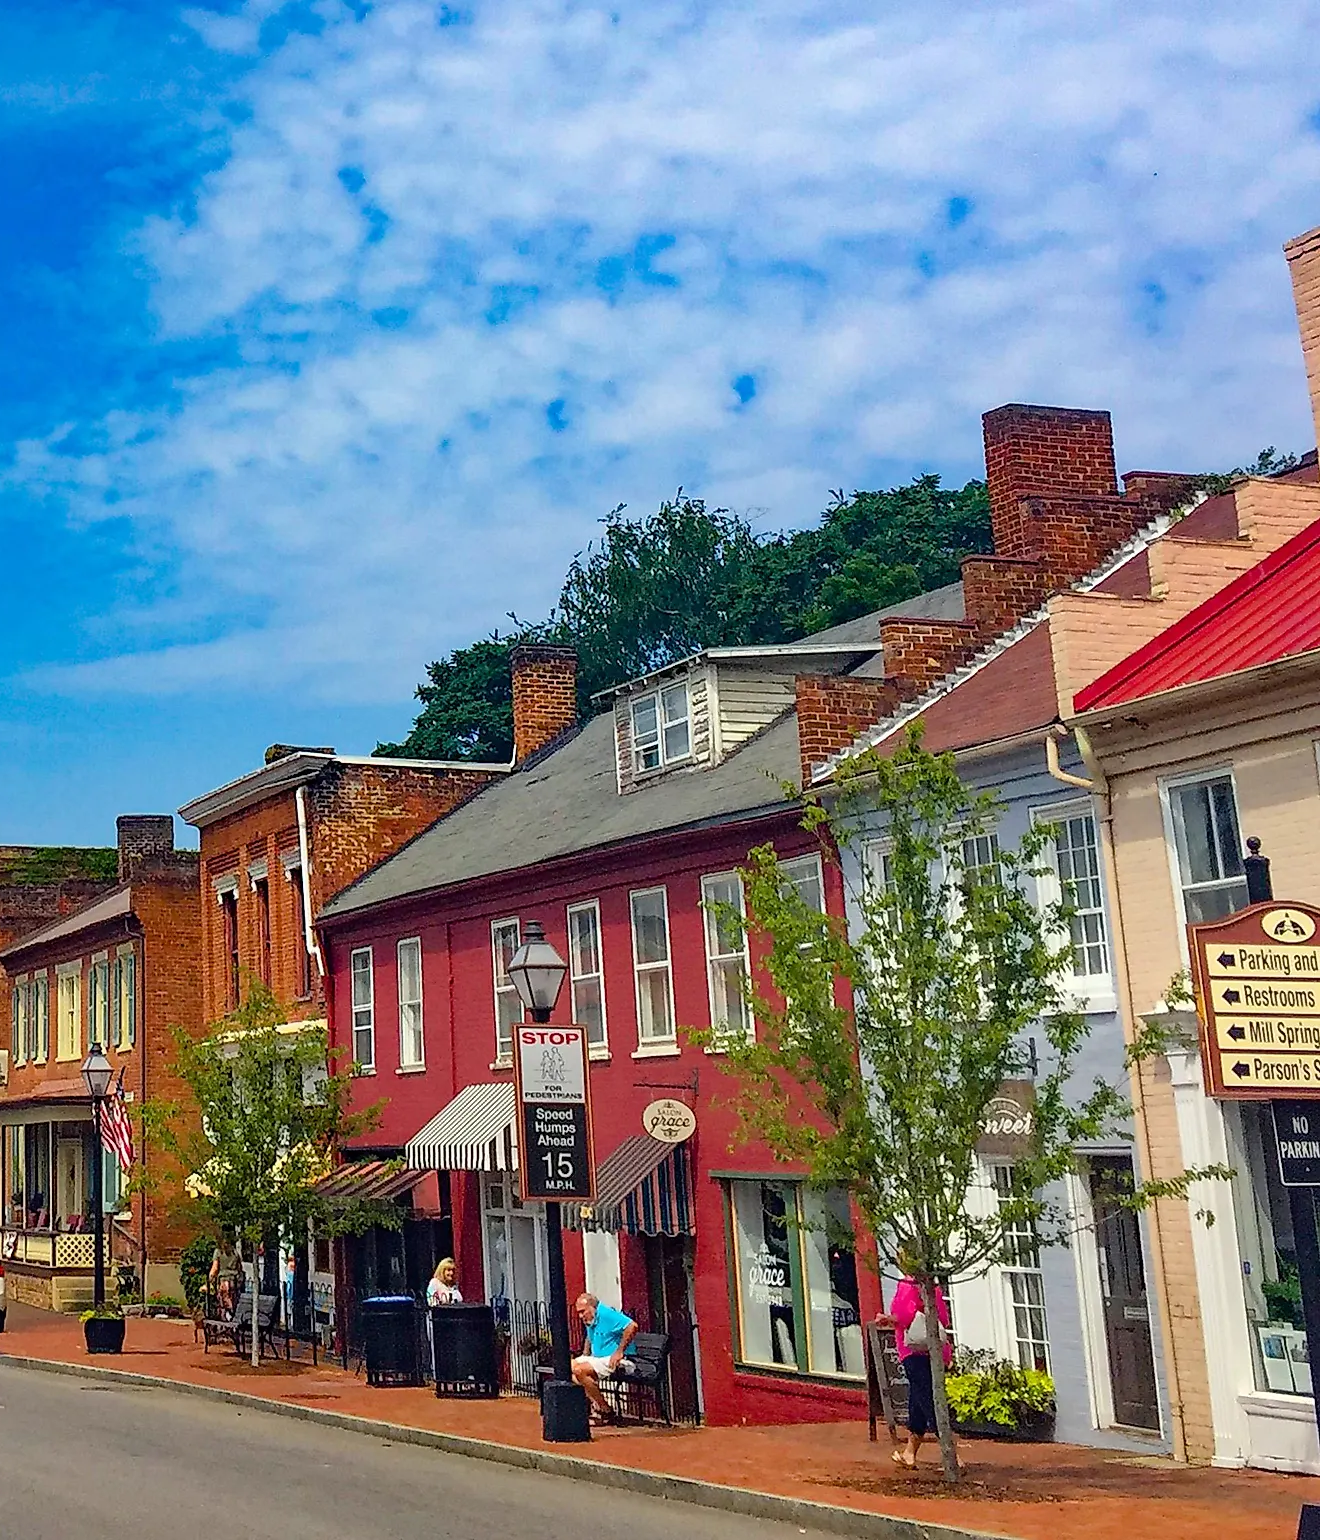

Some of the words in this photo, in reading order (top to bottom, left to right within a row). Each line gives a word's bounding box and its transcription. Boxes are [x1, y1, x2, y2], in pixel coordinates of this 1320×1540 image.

[1239, 948, 1291, 975] Parking
[1293, 950, 1319, 972] and
[1243, 984, 1316, 1008] Restrooms
[521, 1031, 579, 1045] STOP
[1249, 1021, 1275, 1043] Mill
[1277, 1021, 1320, 1049] Spring
[1253, 1057, 1311, 1081] Parson's
[524, 1091, 583, 1100] PEDESTRIANS
[535, 1107, 574, 1121] Speed
[535, 1121, 577, 1135] Humps
[650, 1114, 691, 1134] grace
[1292, 1116, 1309, 1134] NO
[537, 1133, 575, 1147] Ahead
[541, 1151, 574, 1179] 15
[545, 1180, 576, 1190] M.P.H.
[749, 1265, 786, 1297] grace
